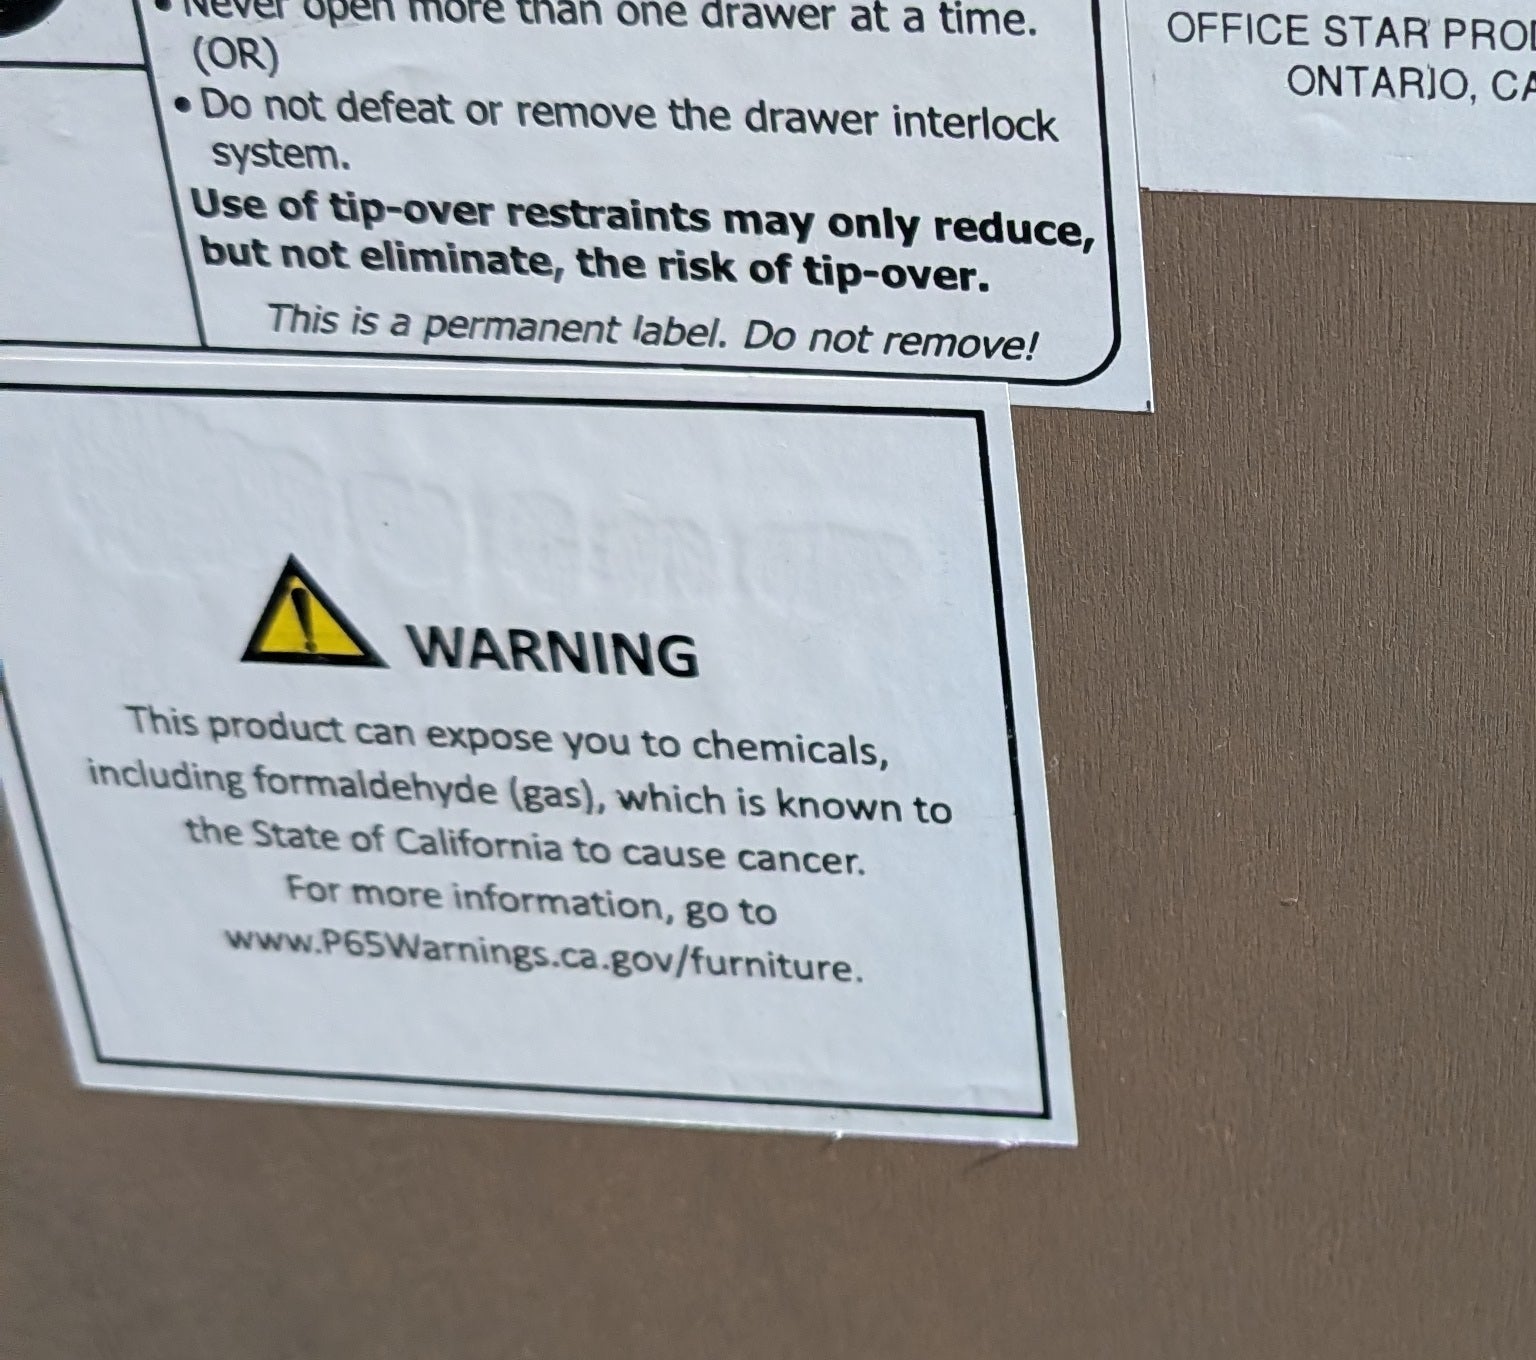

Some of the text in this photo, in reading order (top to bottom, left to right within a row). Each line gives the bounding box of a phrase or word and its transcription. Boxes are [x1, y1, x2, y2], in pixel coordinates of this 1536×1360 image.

[616, 0, 688, 27] one
[850, 0, 890, 33] at
[903, 6, 925, 33] a
[938, 0, 1037, 37] time.
[1167, 10, 1310, 46] OFFICE
[1324, 14, 1431, 49] STAR
[192, 35, 279, 78] (OR)
[1287, 64, 1477, 105] ONTARIO,
[199, 86, 1060, 143] Do not defeat or remove the drawer interlock
[190, 187, 1095, 255] Use of tip-over restraints may only reduce,
[199, 234, 989, 295] but not eliminate, the risk of tip-over.
[267, 302, 1040, 361] This is a permanent label. Do not remove!
[404, 624, 699, 679] WARNING
[123, 704, 889, 772] This product can expose you to chemicals,
[87, 757, 953, 825] including formaldehyde (gas), which is known to
[183, 815, 865, 876] the State of California to cause cancer.
[284, 873, 778, 930] For more information, go to
[223, 927, 863, 983] www.P65Warnings.ca.gov/furniture.
